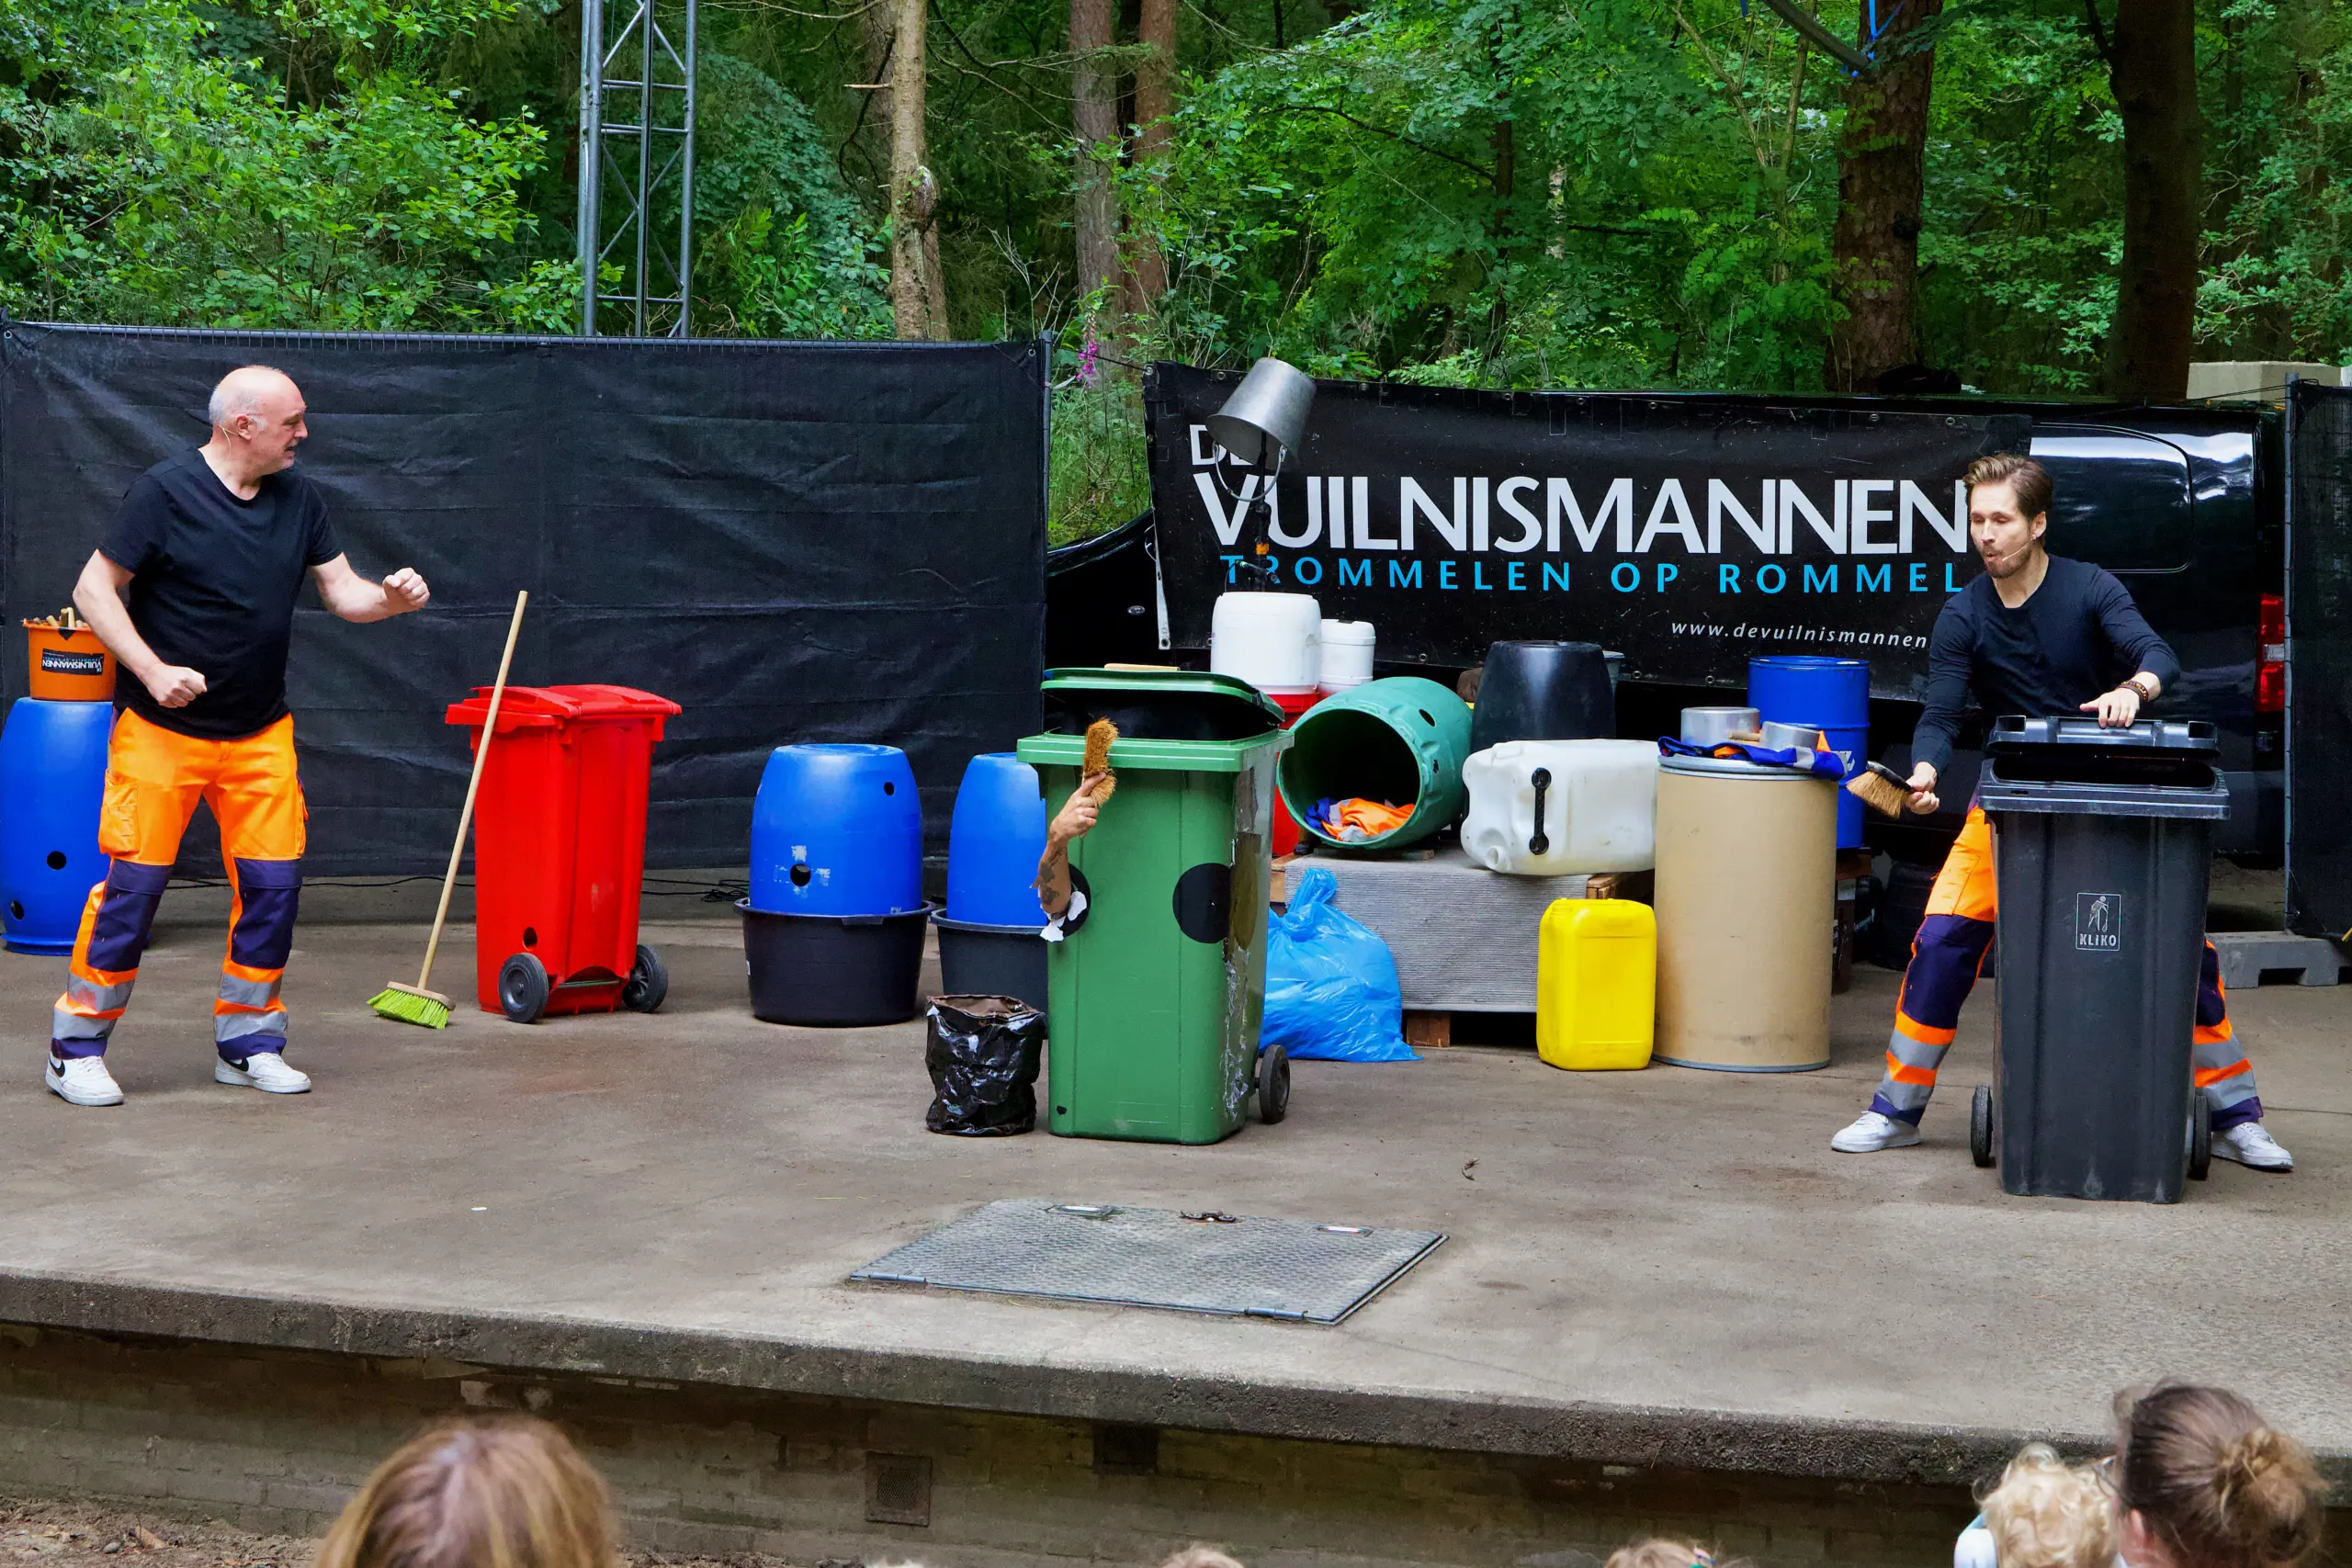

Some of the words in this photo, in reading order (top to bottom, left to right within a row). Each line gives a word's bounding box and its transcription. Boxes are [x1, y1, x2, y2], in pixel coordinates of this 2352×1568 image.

[1190, 424, 1253, 466] D
[1193, 472, 1968, 555] VUILNISMANNEN
[1611, 563, 1679, 593] OP
[1719, 562, 1963, 593] ROMMEL
[1671, 620, 1928, 649] www.devuilnismannen
[2079, 933, 2117, 947] KLIKO
